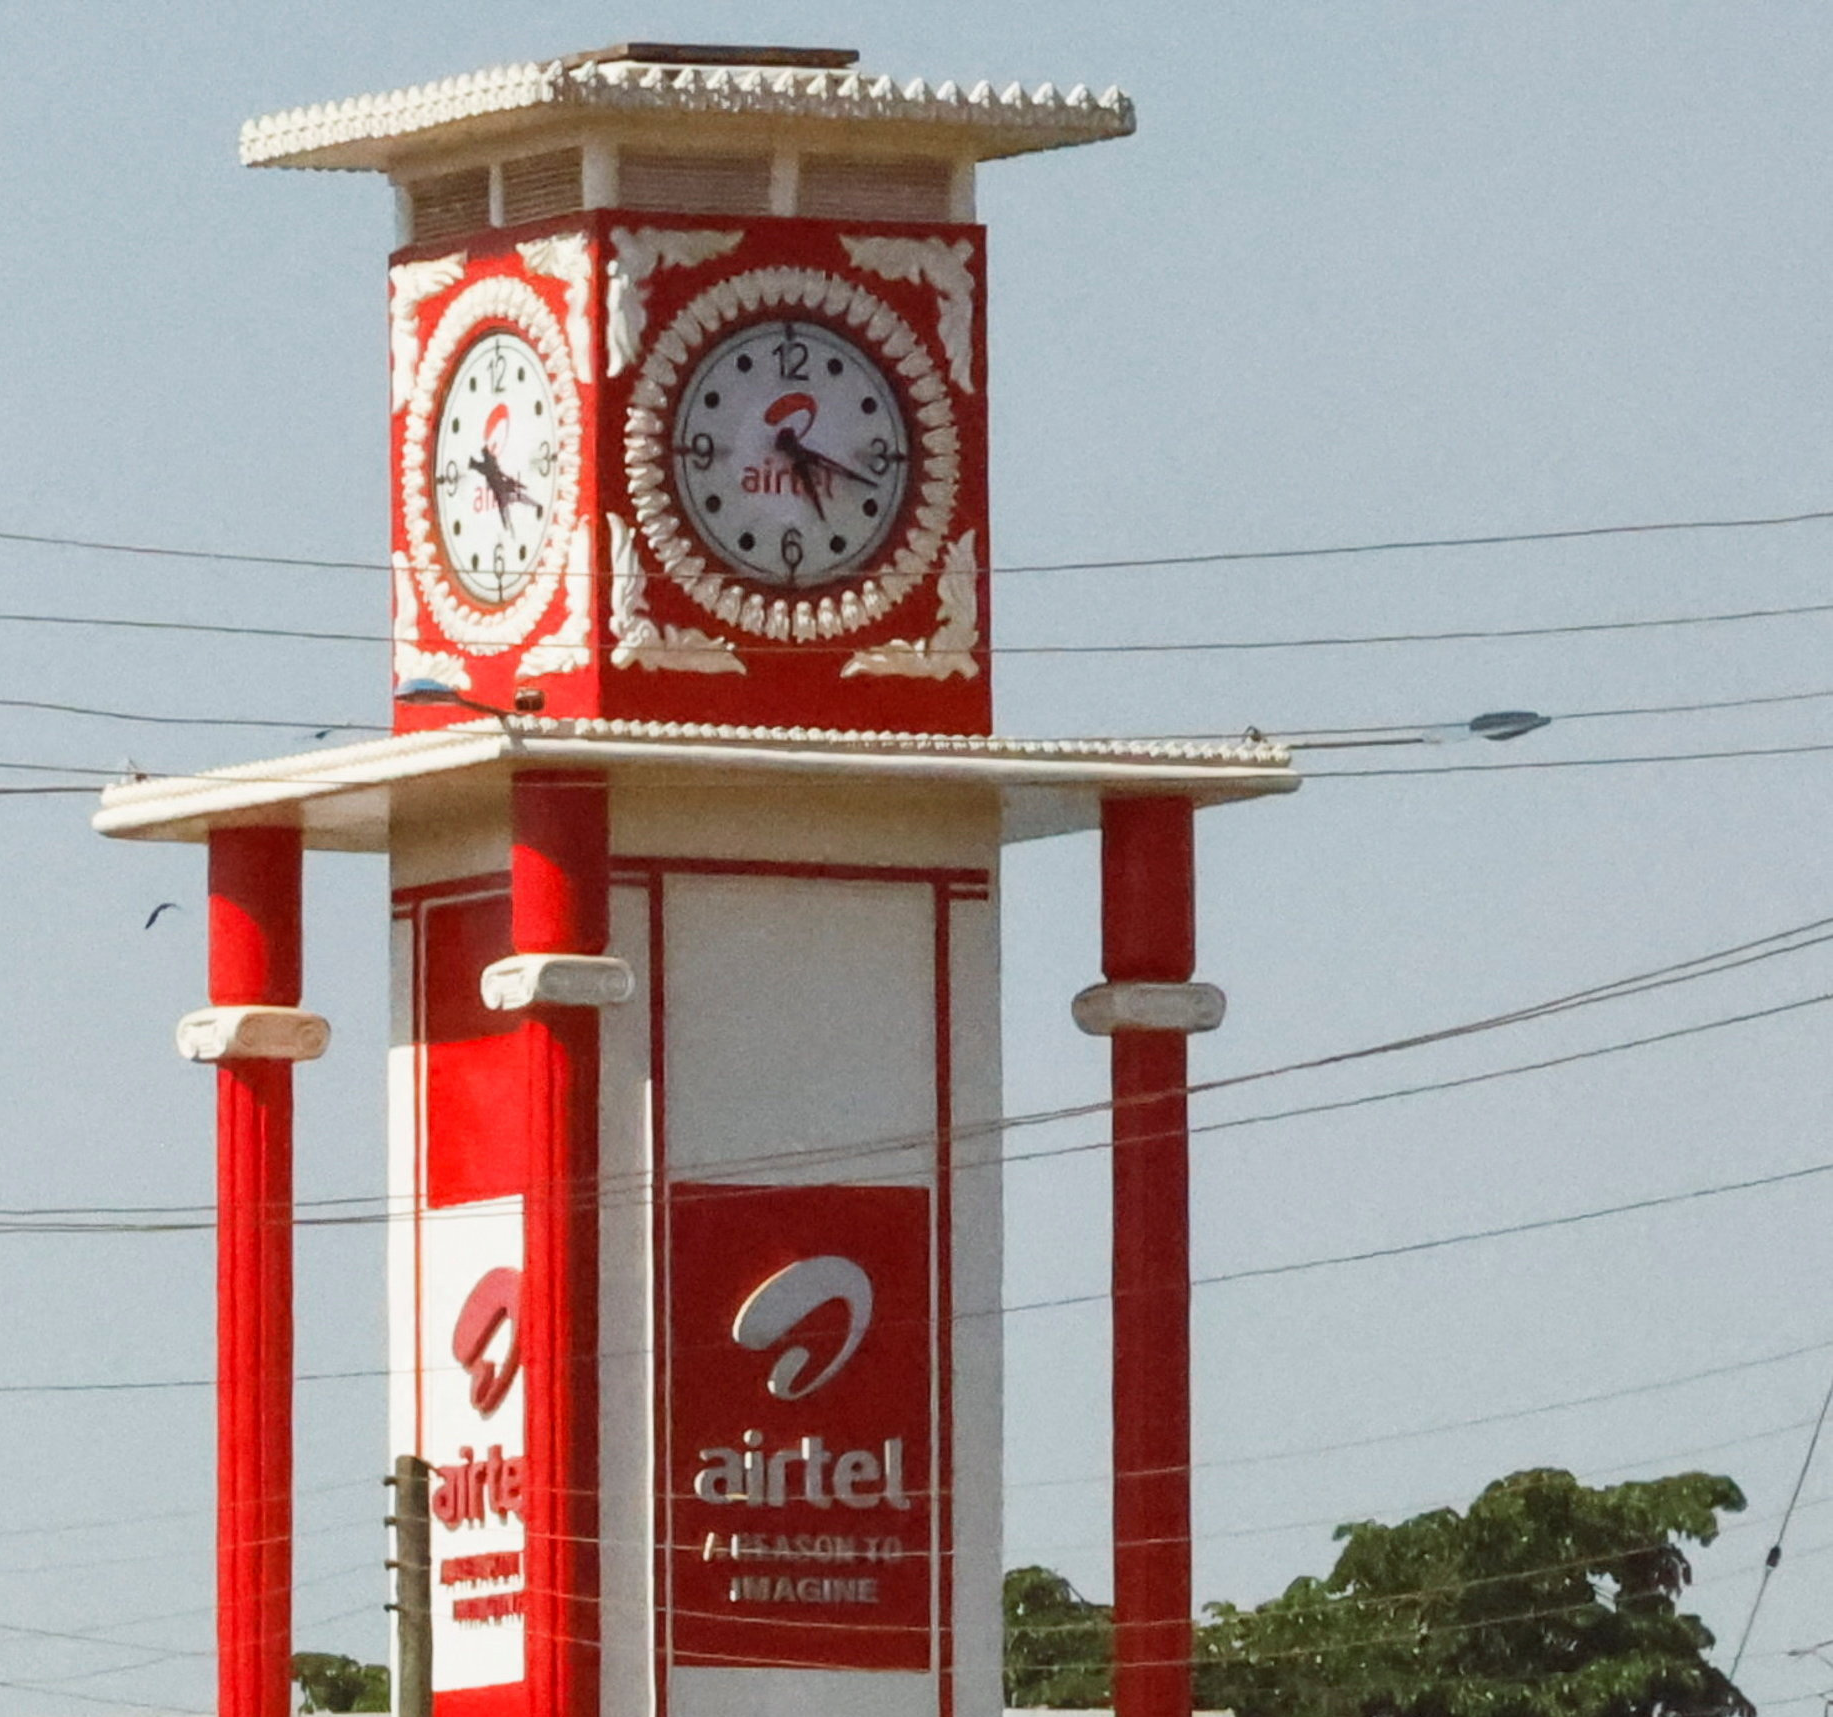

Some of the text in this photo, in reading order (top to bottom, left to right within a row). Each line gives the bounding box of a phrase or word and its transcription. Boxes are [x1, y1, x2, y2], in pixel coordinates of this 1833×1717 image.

[487, 356, 506, 394] 12
[772, 343, 809, 381] 12
[538, 441, 550, 477] 3
[692, 433, 714, 470] 9
[869, 438, 888, 475] 3
[446, 460, 458, 497] 9
[493, 543, 505, 579] 6
[782, 528, 803, 566] 6
[433, 1444, 525, 1532] airte
[694, 1429, 911, 1510] airtel
[731, 1533, 855, 1563] REASON
[863, 1536, 903, 1563] TO
[730, 1576, 879, 1603] IMAGINE
